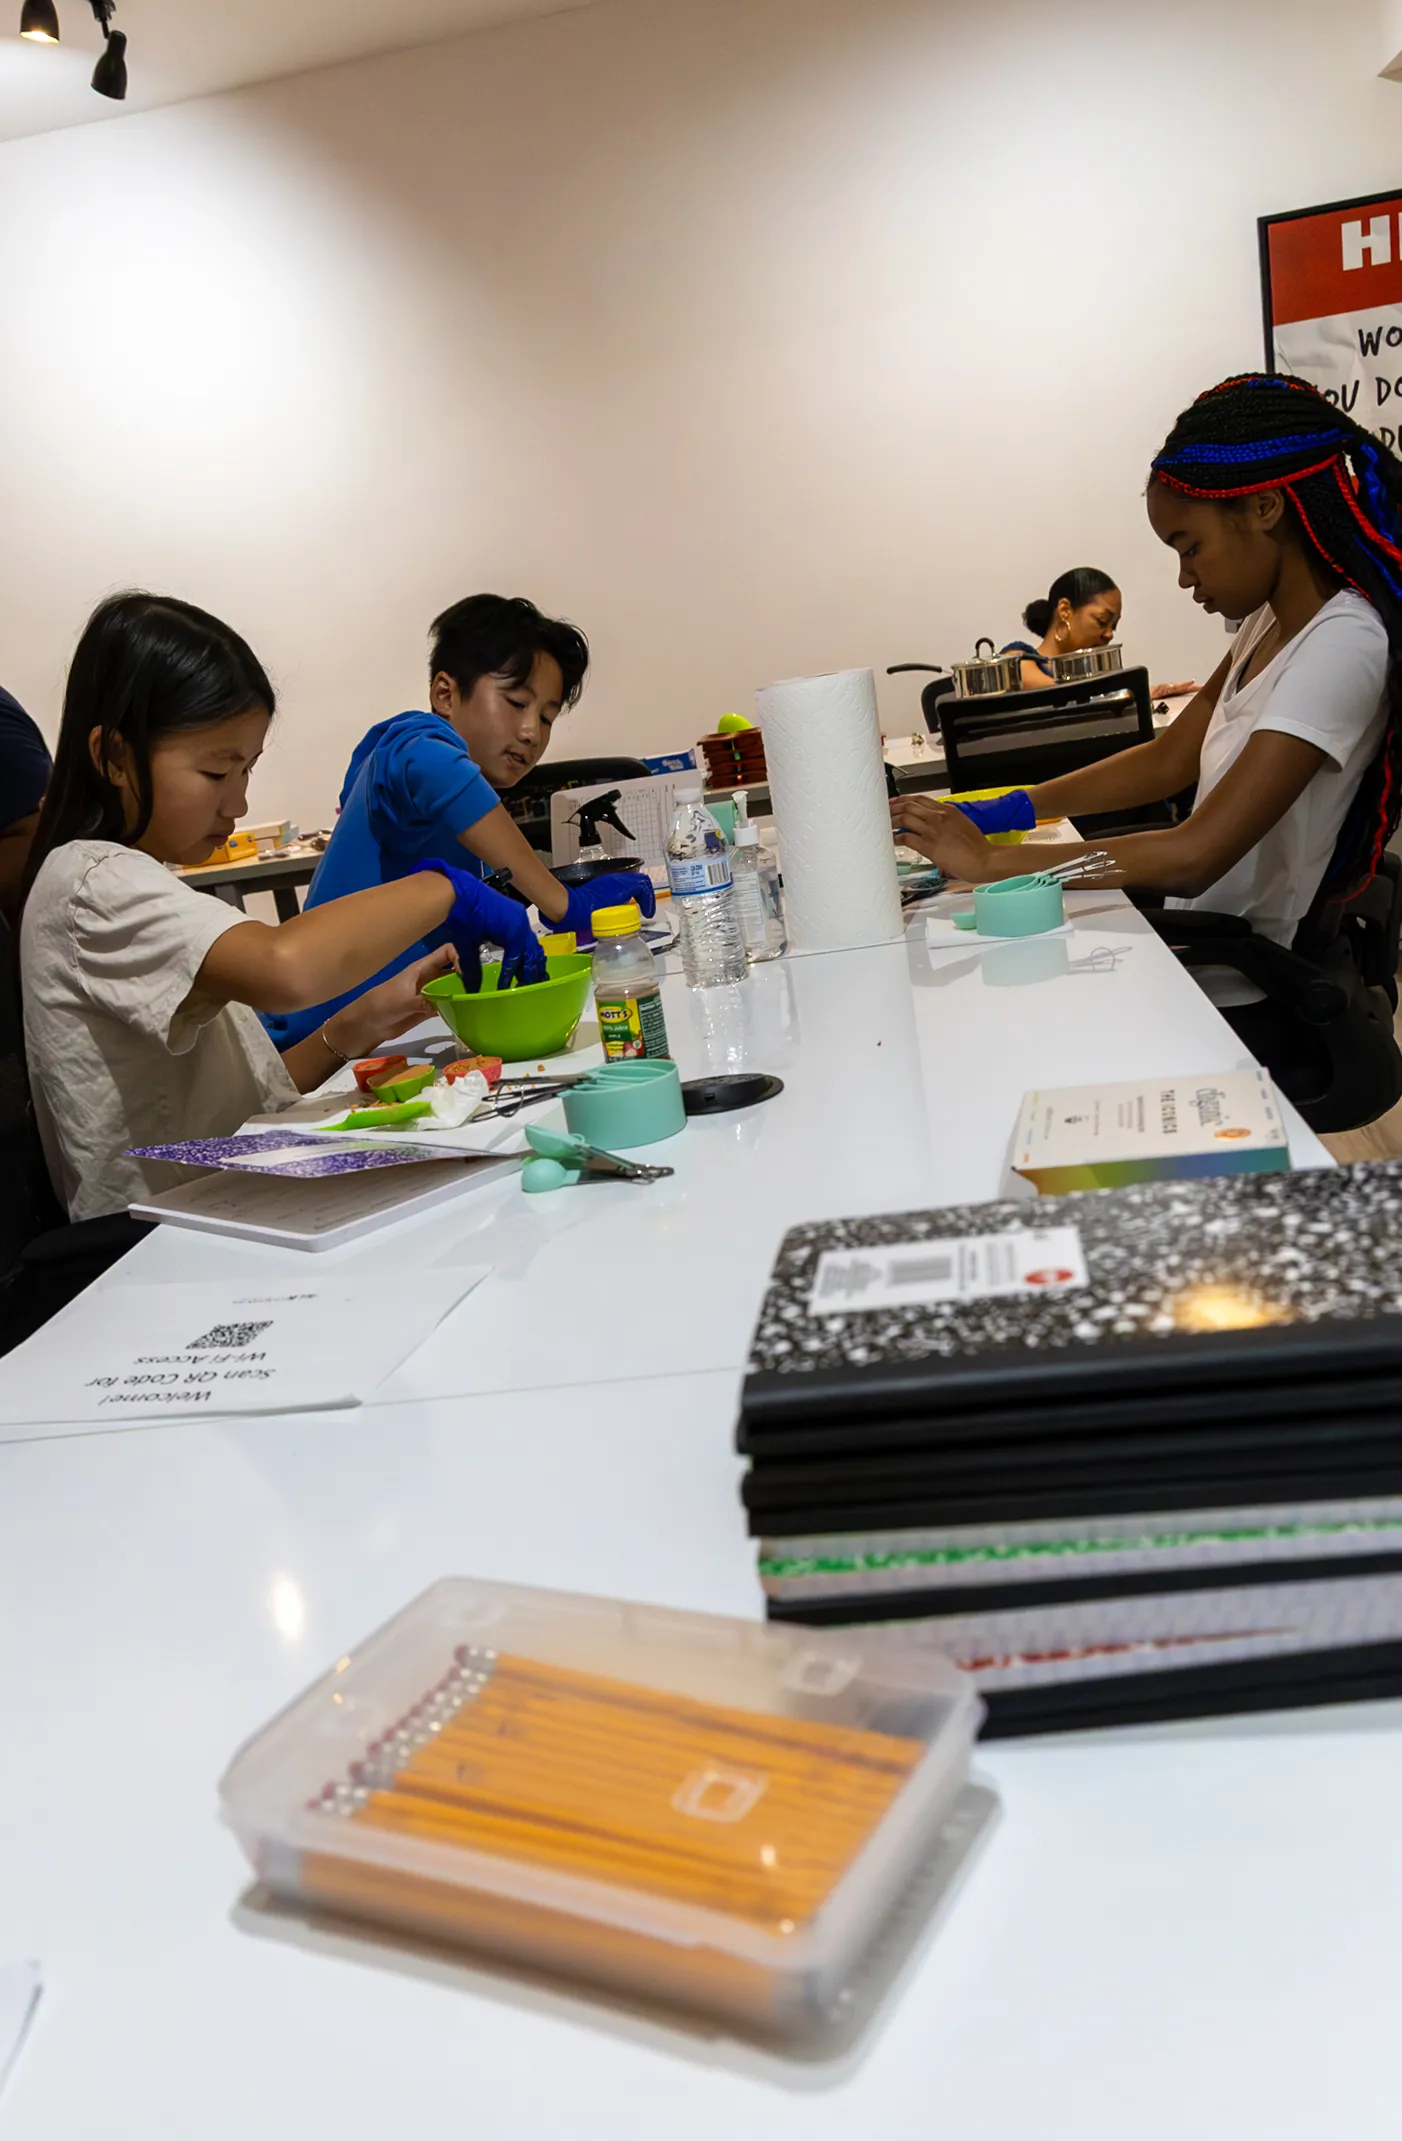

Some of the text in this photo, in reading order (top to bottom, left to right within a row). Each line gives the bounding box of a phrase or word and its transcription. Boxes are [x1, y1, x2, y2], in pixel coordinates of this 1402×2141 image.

[133, 1352, 266, 1364] Wi-Fi Access
[85, 1369, 276, 1387] Scan QR Code for
[98, 1390, 212, 1406] Welcome!
